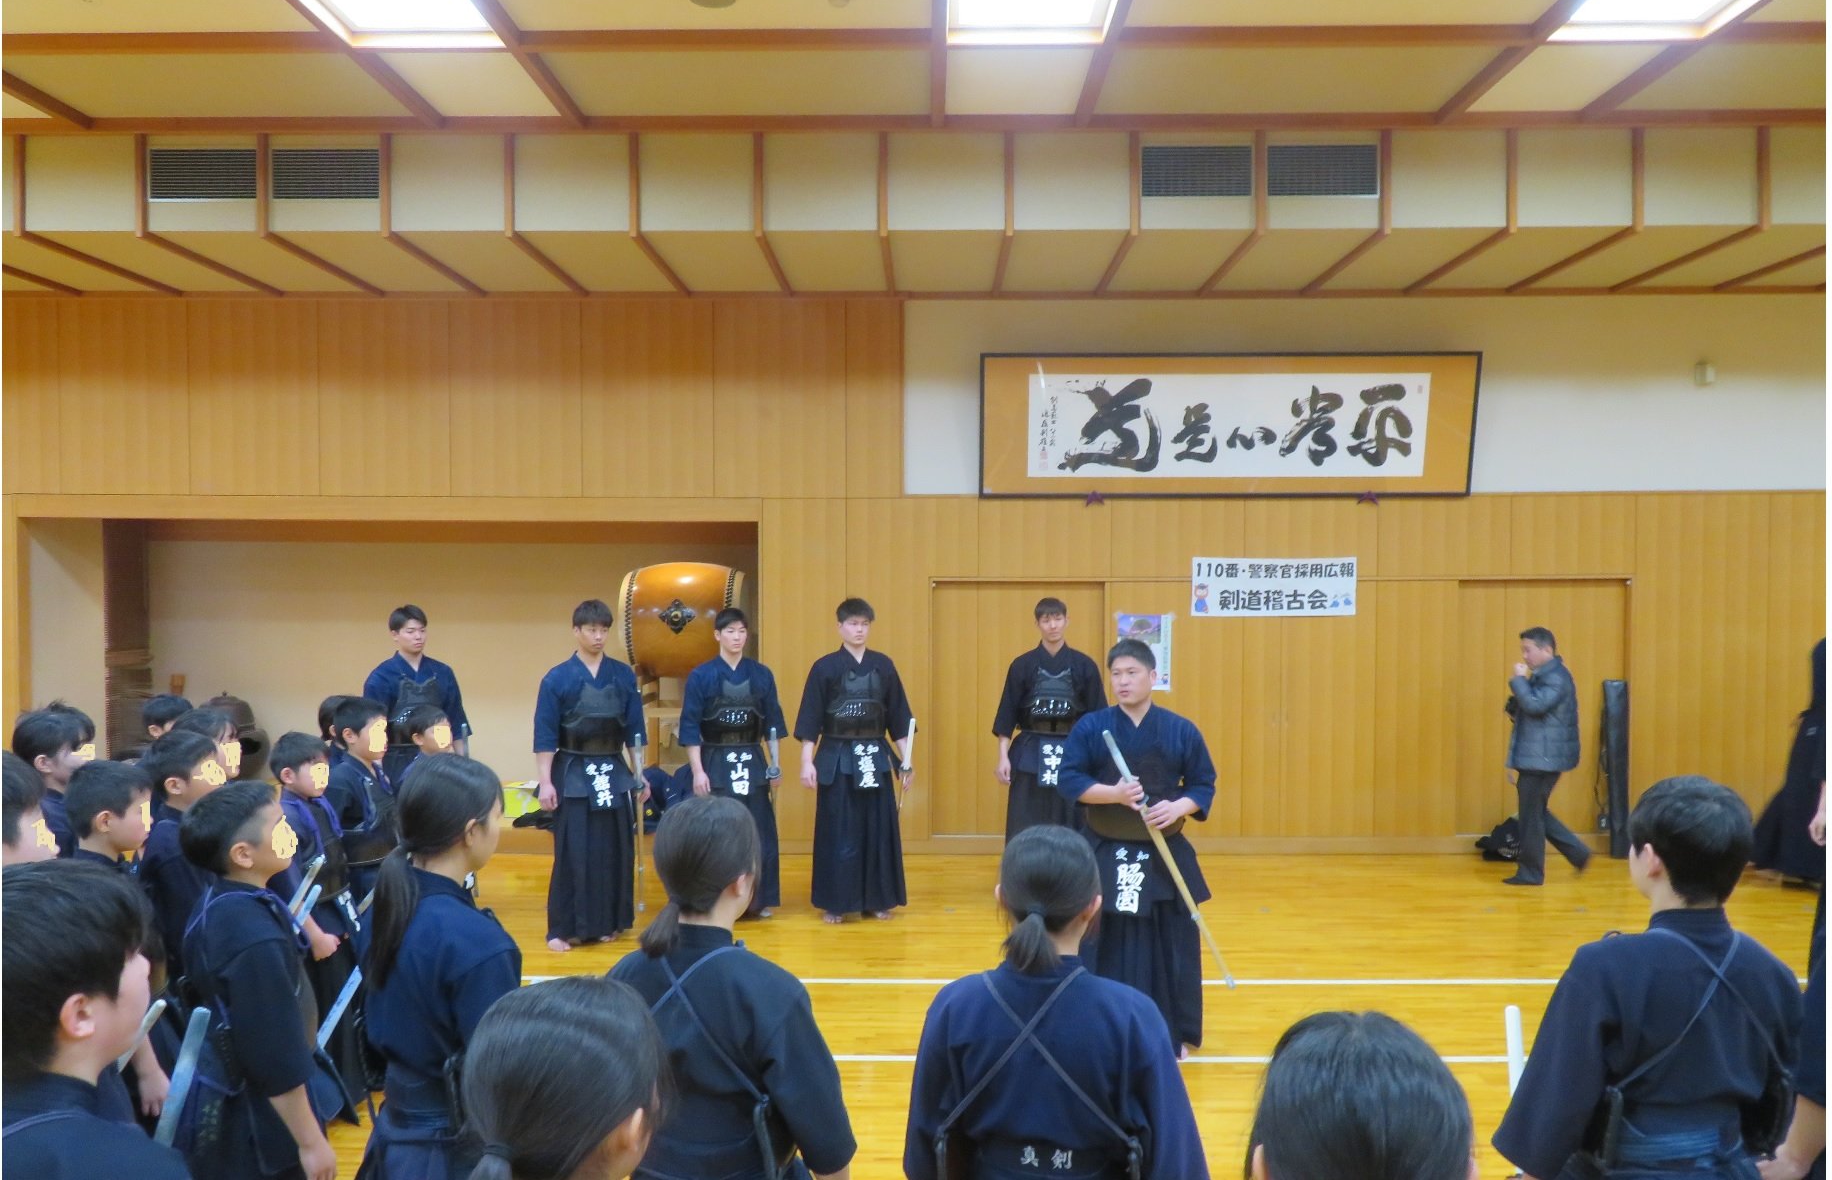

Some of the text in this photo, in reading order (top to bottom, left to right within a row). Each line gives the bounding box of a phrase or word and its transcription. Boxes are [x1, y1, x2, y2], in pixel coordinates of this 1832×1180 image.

[1219, 589, 1328, 611] 剣道稽古会
[854, 744, 879, 756] 愛知
[585, 763, 614, 776] 愛知
[730, 762, 750, 796] 山田
[858, 755, 879, 788] 塩屋
[1041, 755, 1062, 785] 中村
[1115, 847, 1150, 861] 愛知
[1020, 1145, 1073, 1170] 真剣
